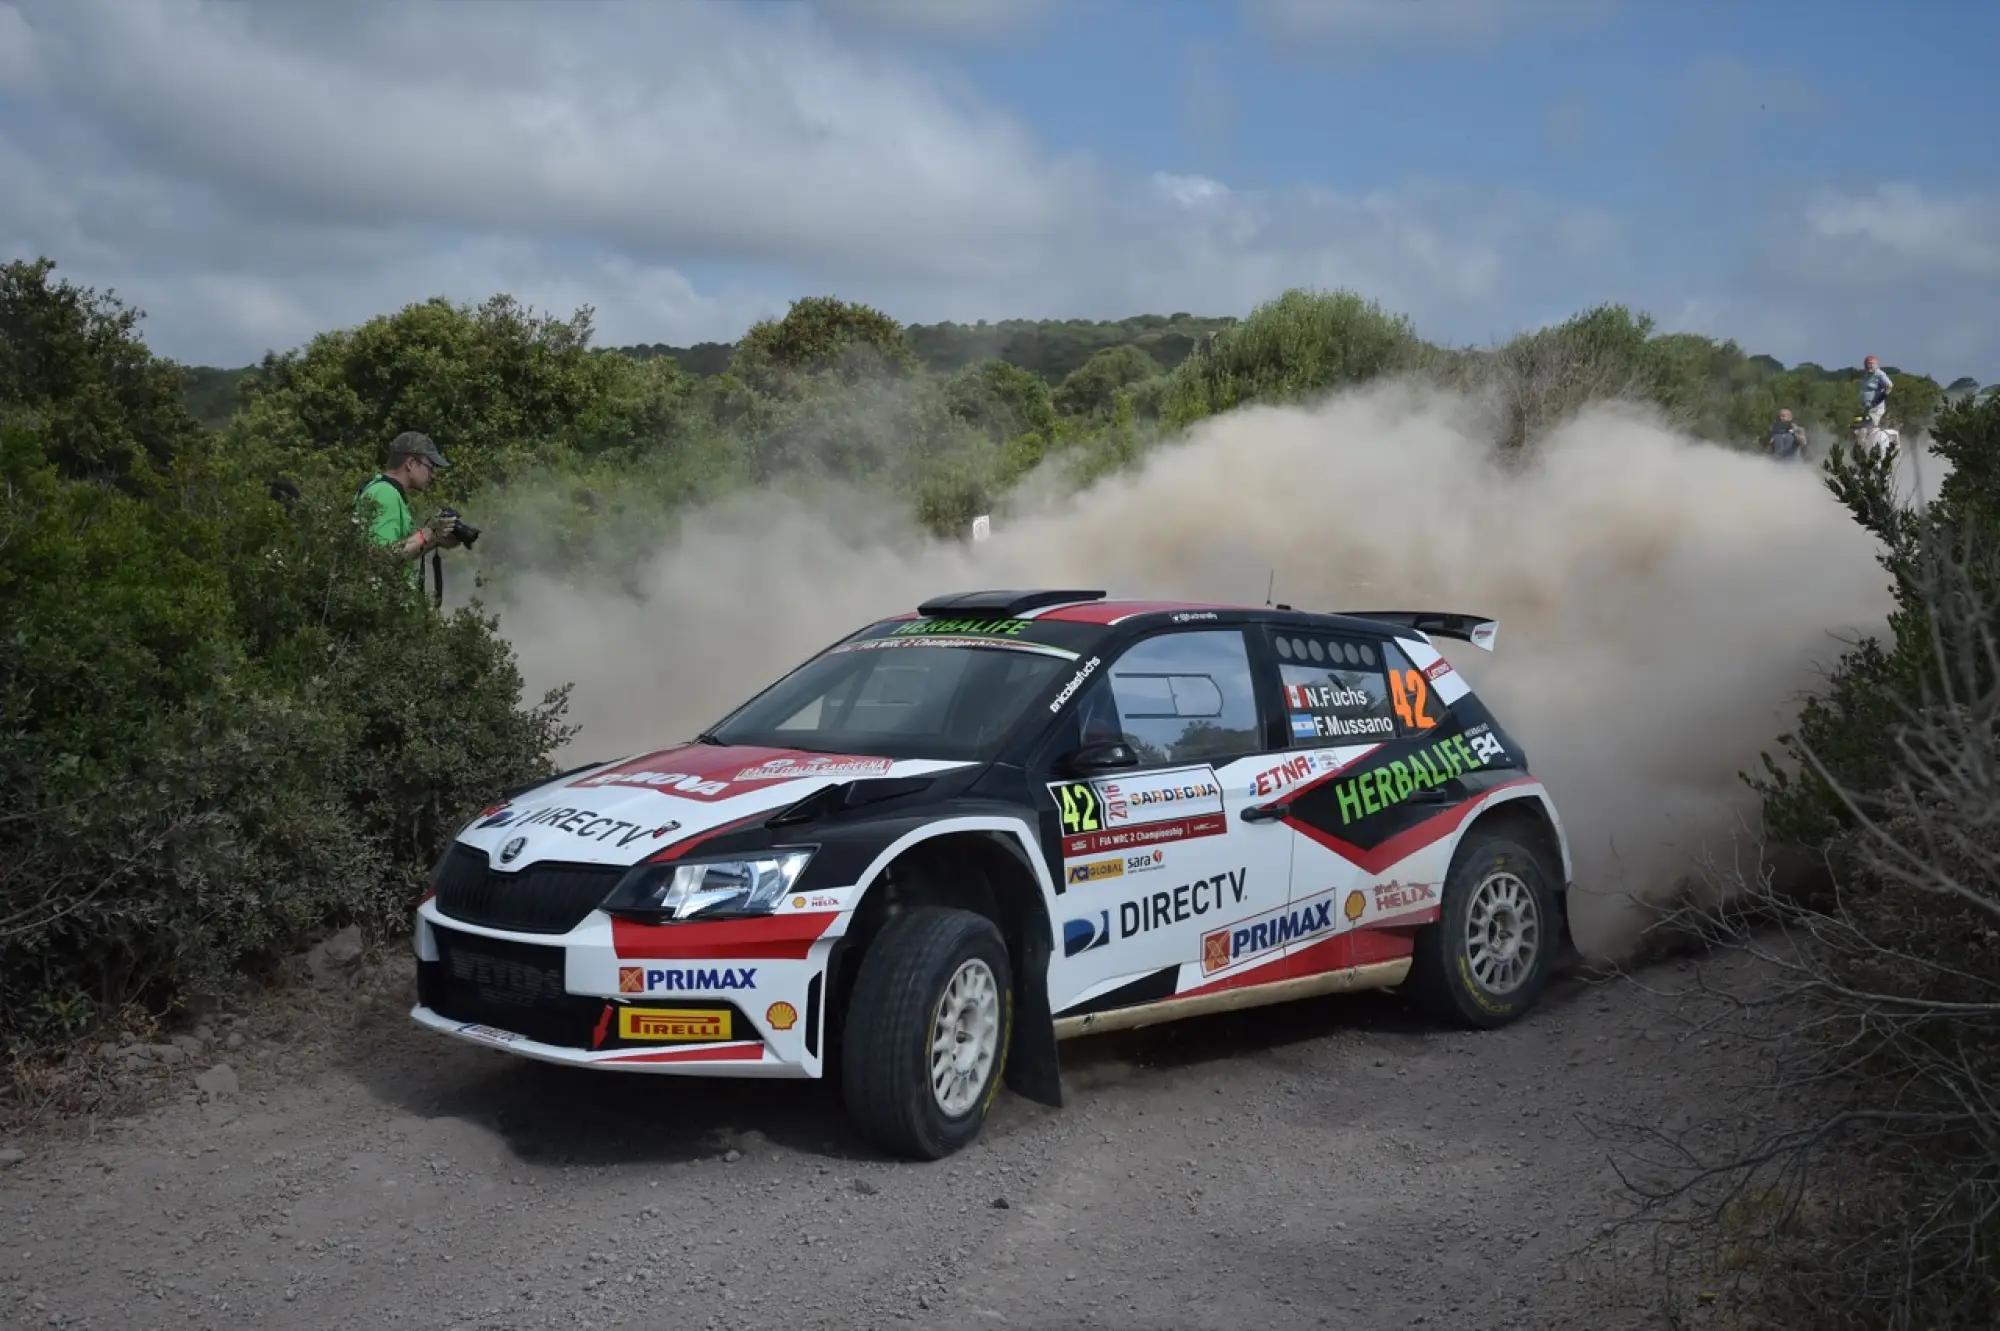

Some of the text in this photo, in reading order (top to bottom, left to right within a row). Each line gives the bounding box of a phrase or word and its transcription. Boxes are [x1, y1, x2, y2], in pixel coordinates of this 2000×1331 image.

[891, 619, 1032, 635] HERBALIFE
[1305, 685, 1368, 708] N.Fuchs
[1388, 669, 1437, 729] 42
[1314, 713, 1394, 738] F.Mussano
[1471, 731, 1505, 765] 24
[1256, 755, 1312, 797] ETNA
[1335, 733, 1481, 825] HERBALIFE
[1130, 783, 1218, 806] SARDEGNA
[1060, 783, 1098, 832] 42
[1130, 831, 1136, 842] 2
[1136, 825, 1184, 842] Championship
[1089, 863, 1123, 877] GLOBAL
[1128, 854, 1151, 870] sara
[1231, 899, 1332, 959] PRIMAX
[647, 968, 758, 991] PRIMAX
[631, 1014, 720, 1035] PIRELLI
